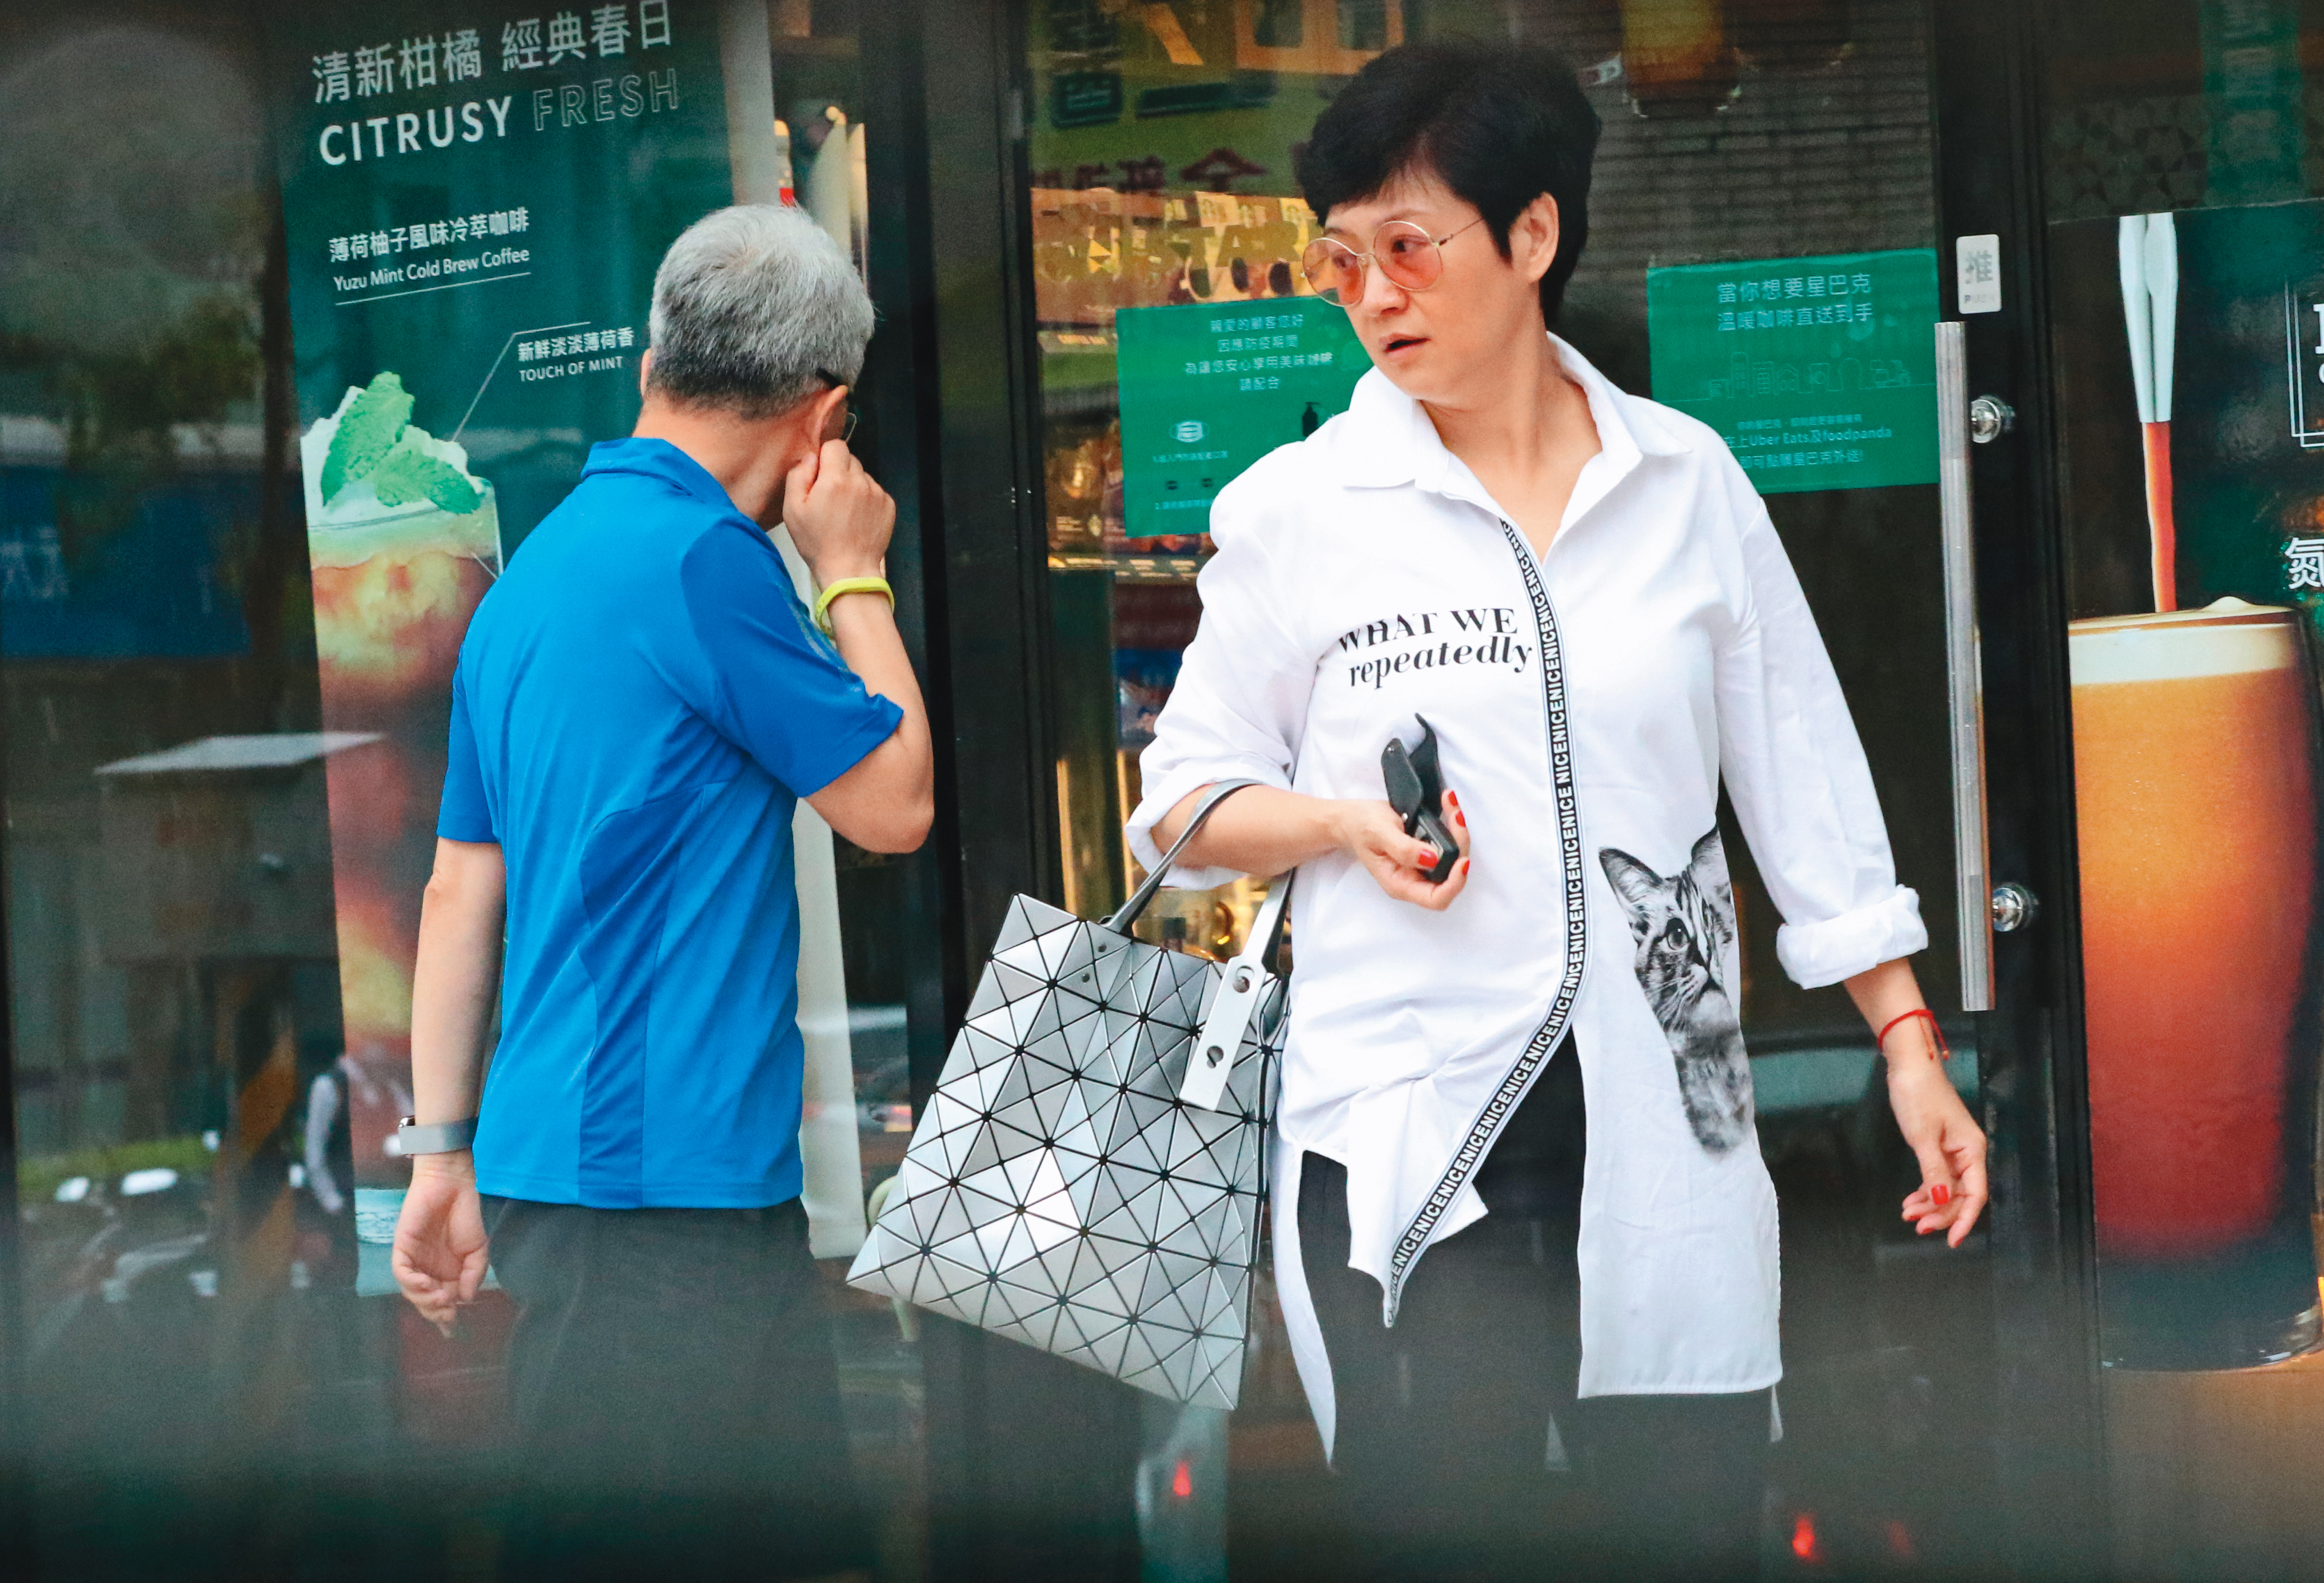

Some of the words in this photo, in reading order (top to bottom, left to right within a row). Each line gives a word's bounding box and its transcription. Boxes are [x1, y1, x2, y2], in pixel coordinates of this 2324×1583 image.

[312, 29, 481, 103] 清新柑橘
[501, 1, 672, 72] 經典春日
[320, 96, 512, 165] CITRUSY
[532, 68, 679, 131] FRESH
[329, 206, 529, 262] 薄荷柚子風味冷萃咖啡
[333, 276, 367, 292] Yuzu
[370, 268, 404, 286] Mint
[406, 260, 440, 280] Cold
[443, 258, 479, 275] Brew
[481, 247, 529, 268] Coffee
[1717, 273, 1872, 304] 當你想要星巴克
[1965, 250, 1993, 284] 推
[518, 326, 634, 361] 新鮮淡淡薄荷香
[519, 364, 564, 382] TOUCH
[568, 361, 585, 374] OF
[589, 356, 623, 371] MINT
[1338, 613, 1438, 652] WHAT
[1449, 608, 1517, 635] WE
[1349, 636, 1532, 689] repeatedly
